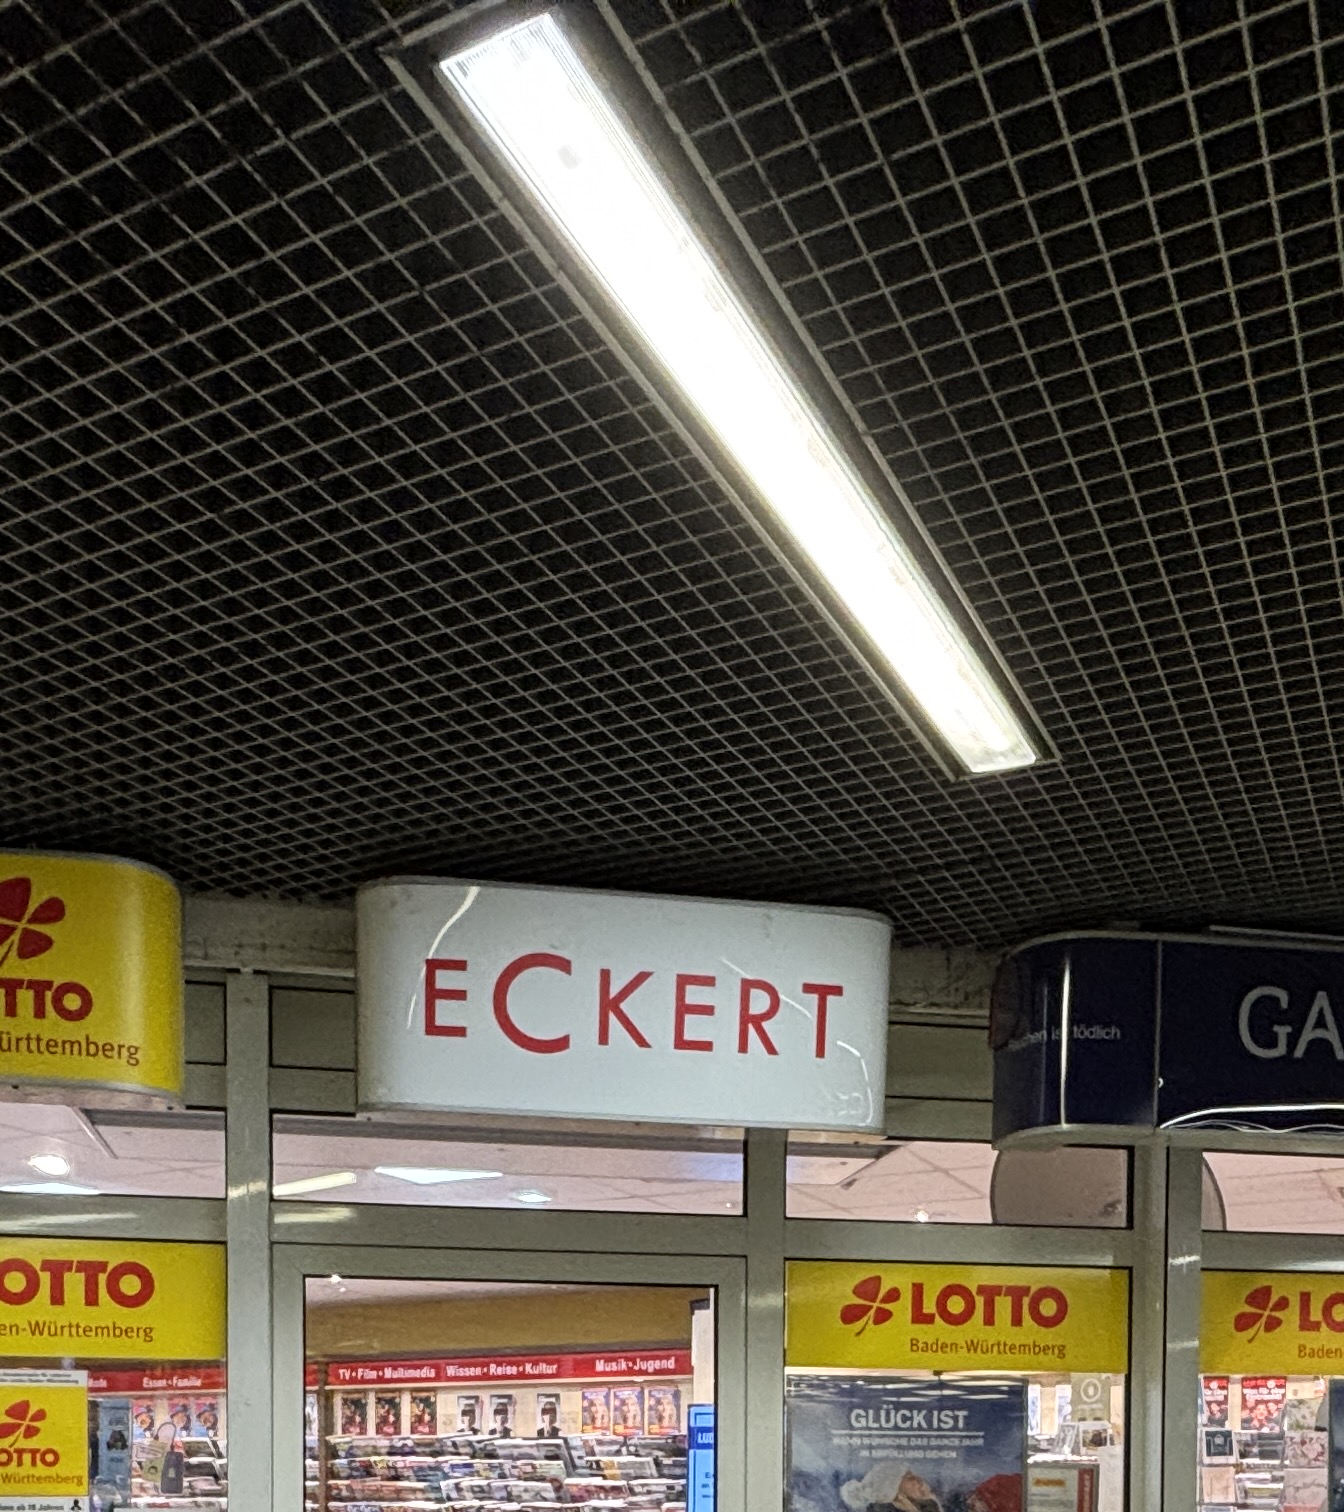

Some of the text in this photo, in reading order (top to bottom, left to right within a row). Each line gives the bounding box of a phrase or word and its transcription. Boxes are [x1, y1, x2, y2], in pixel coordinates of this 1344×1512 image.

[425, 953, 843, 1058] ECKERT
[1073, 1023, 1121, 1040] tödlich
[910, 1282, 1068, 1328] LOTTO
[910, 1337, 1066, 1359] Baden-Württemberg
[596, 1357, 676, 1373] Musik Jugend
[851, 1404, 968, 1429] GLÜCK IST
